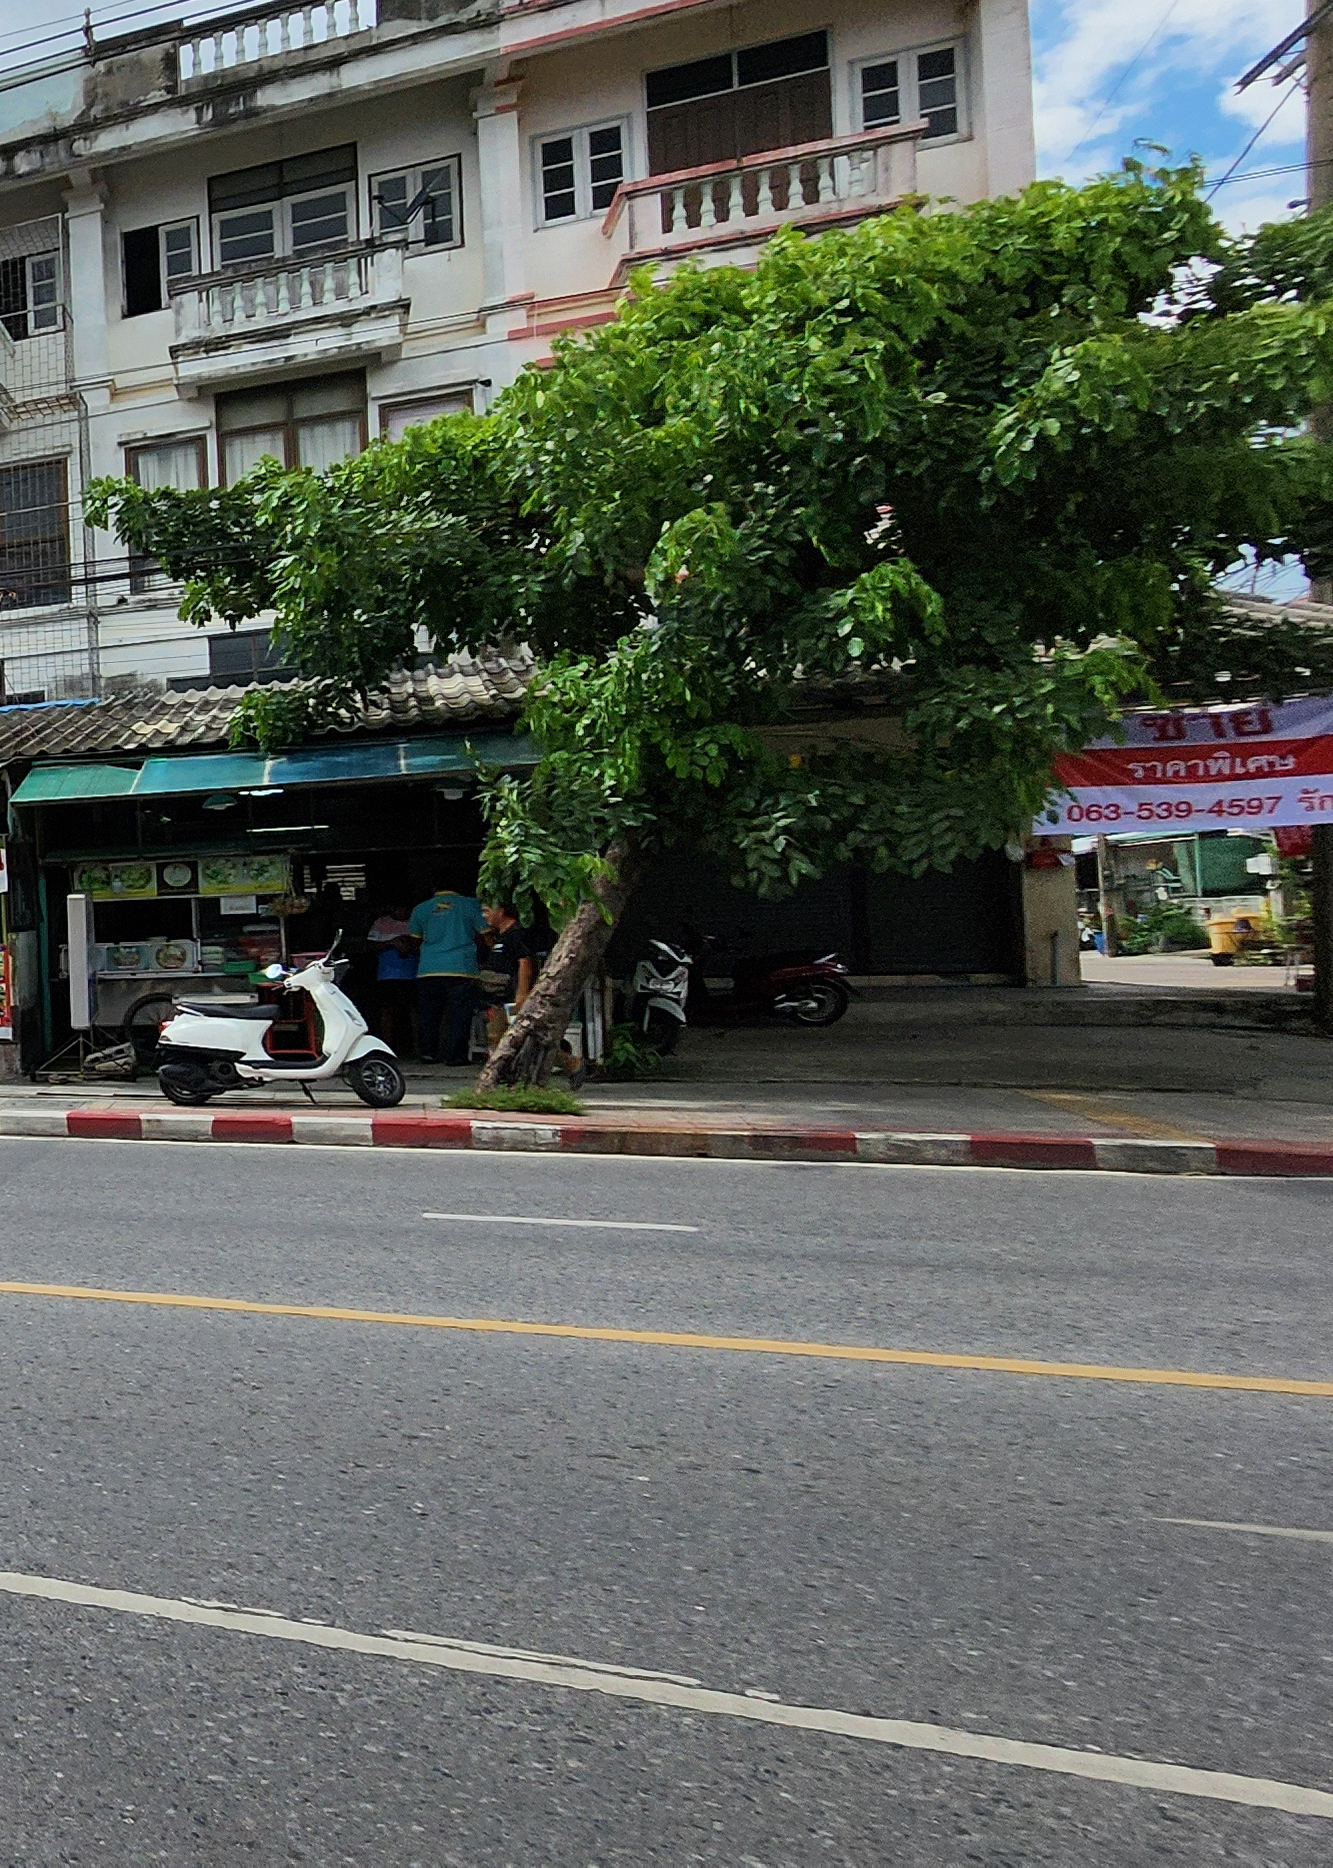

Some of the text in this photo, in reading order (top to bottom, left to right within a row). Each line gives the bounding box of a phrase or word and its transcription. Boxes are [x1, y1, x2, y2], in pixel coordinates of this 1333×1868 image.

[1141, 707, 1274, 742] ขาย
[1126, 750, 1296, 779] ราคาพิเศษ
[1066, 795, 1283, 823] 063-539-4597
